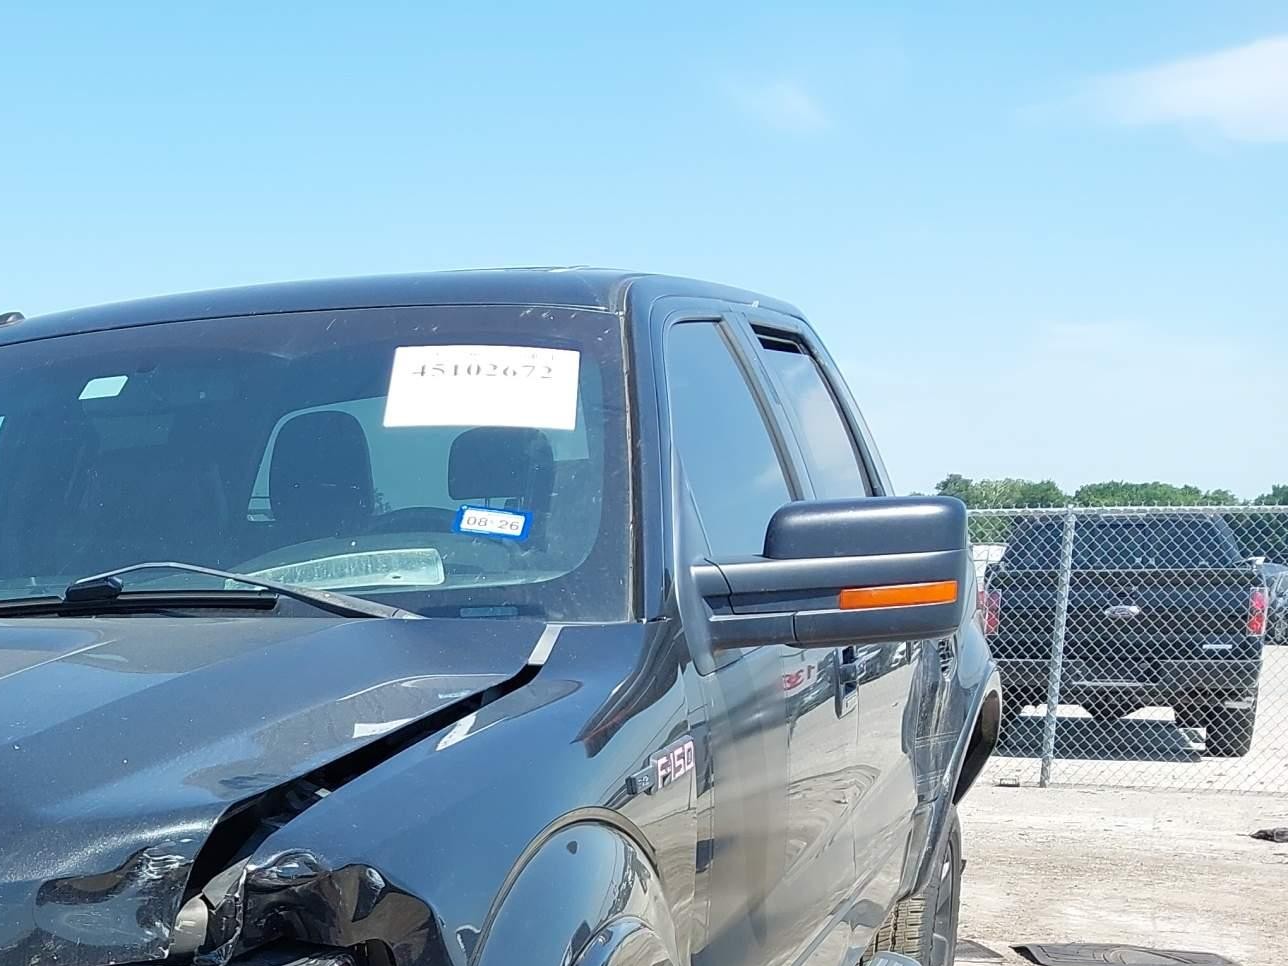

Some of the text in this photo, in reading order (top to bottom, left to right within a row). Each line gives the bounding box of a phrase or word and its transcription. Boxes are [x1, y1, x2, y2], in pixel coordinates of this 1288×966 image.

[412, 363, 553, 379] 45102672
[466, 516, 520, 531] 08 26
